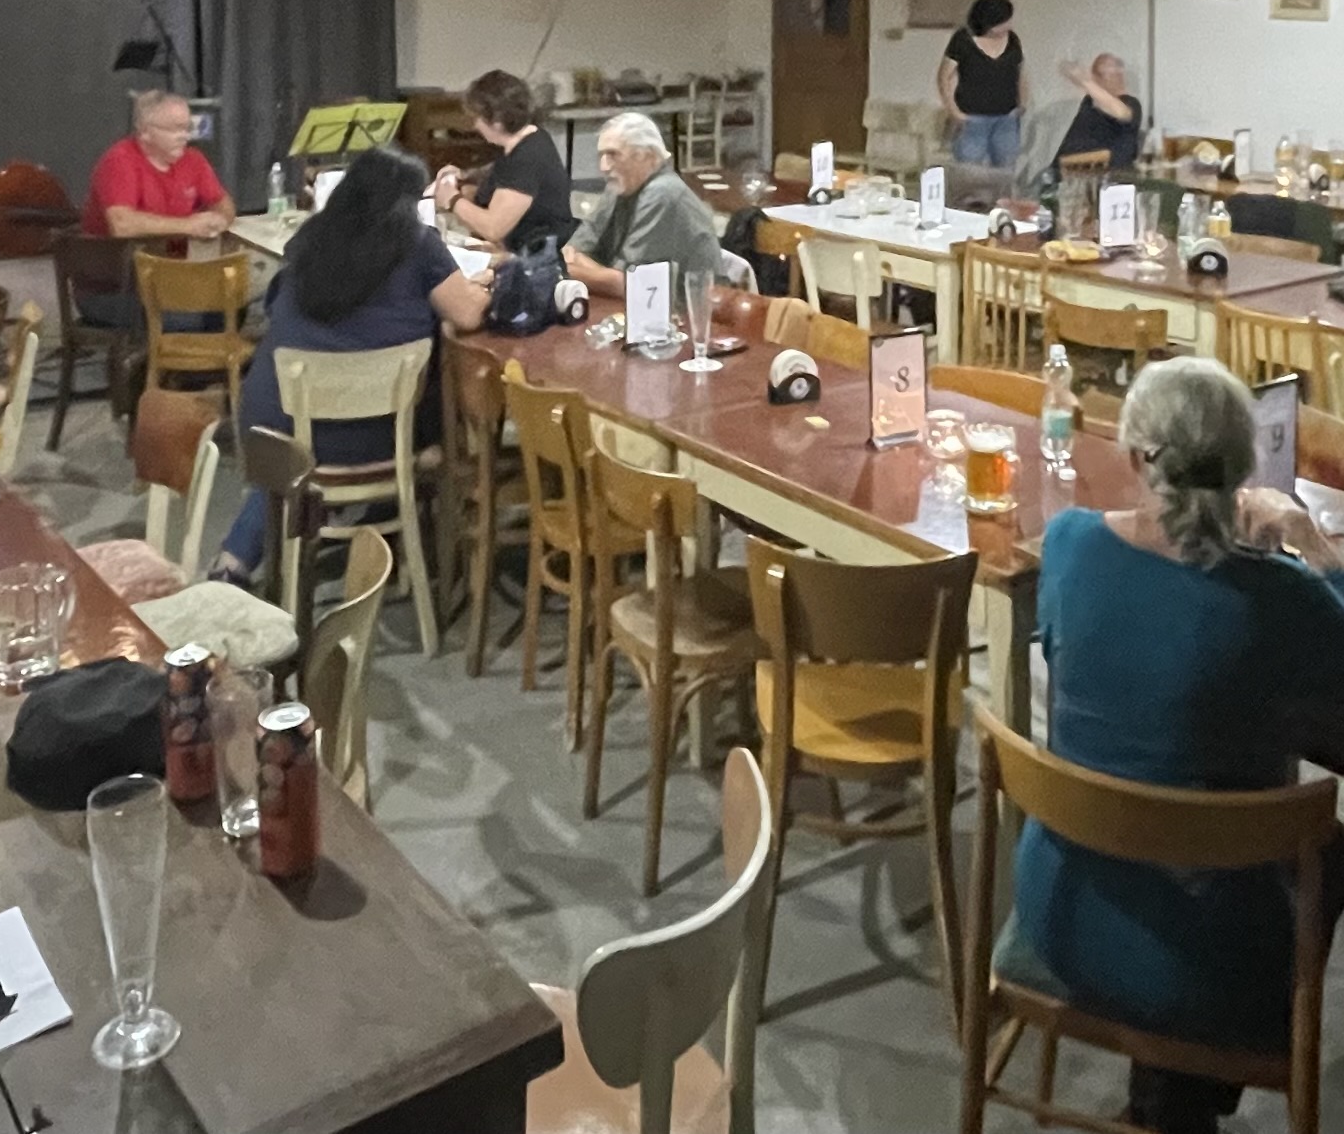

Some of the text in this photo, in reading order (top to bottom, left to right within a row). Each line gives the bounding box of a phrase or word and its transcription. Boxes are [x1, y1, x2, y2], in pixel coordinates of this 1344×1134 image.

[1110, 202, 1131, 221] 12
[646, 286, 658, 309] 7
[895, 366, 910, 393] 8
